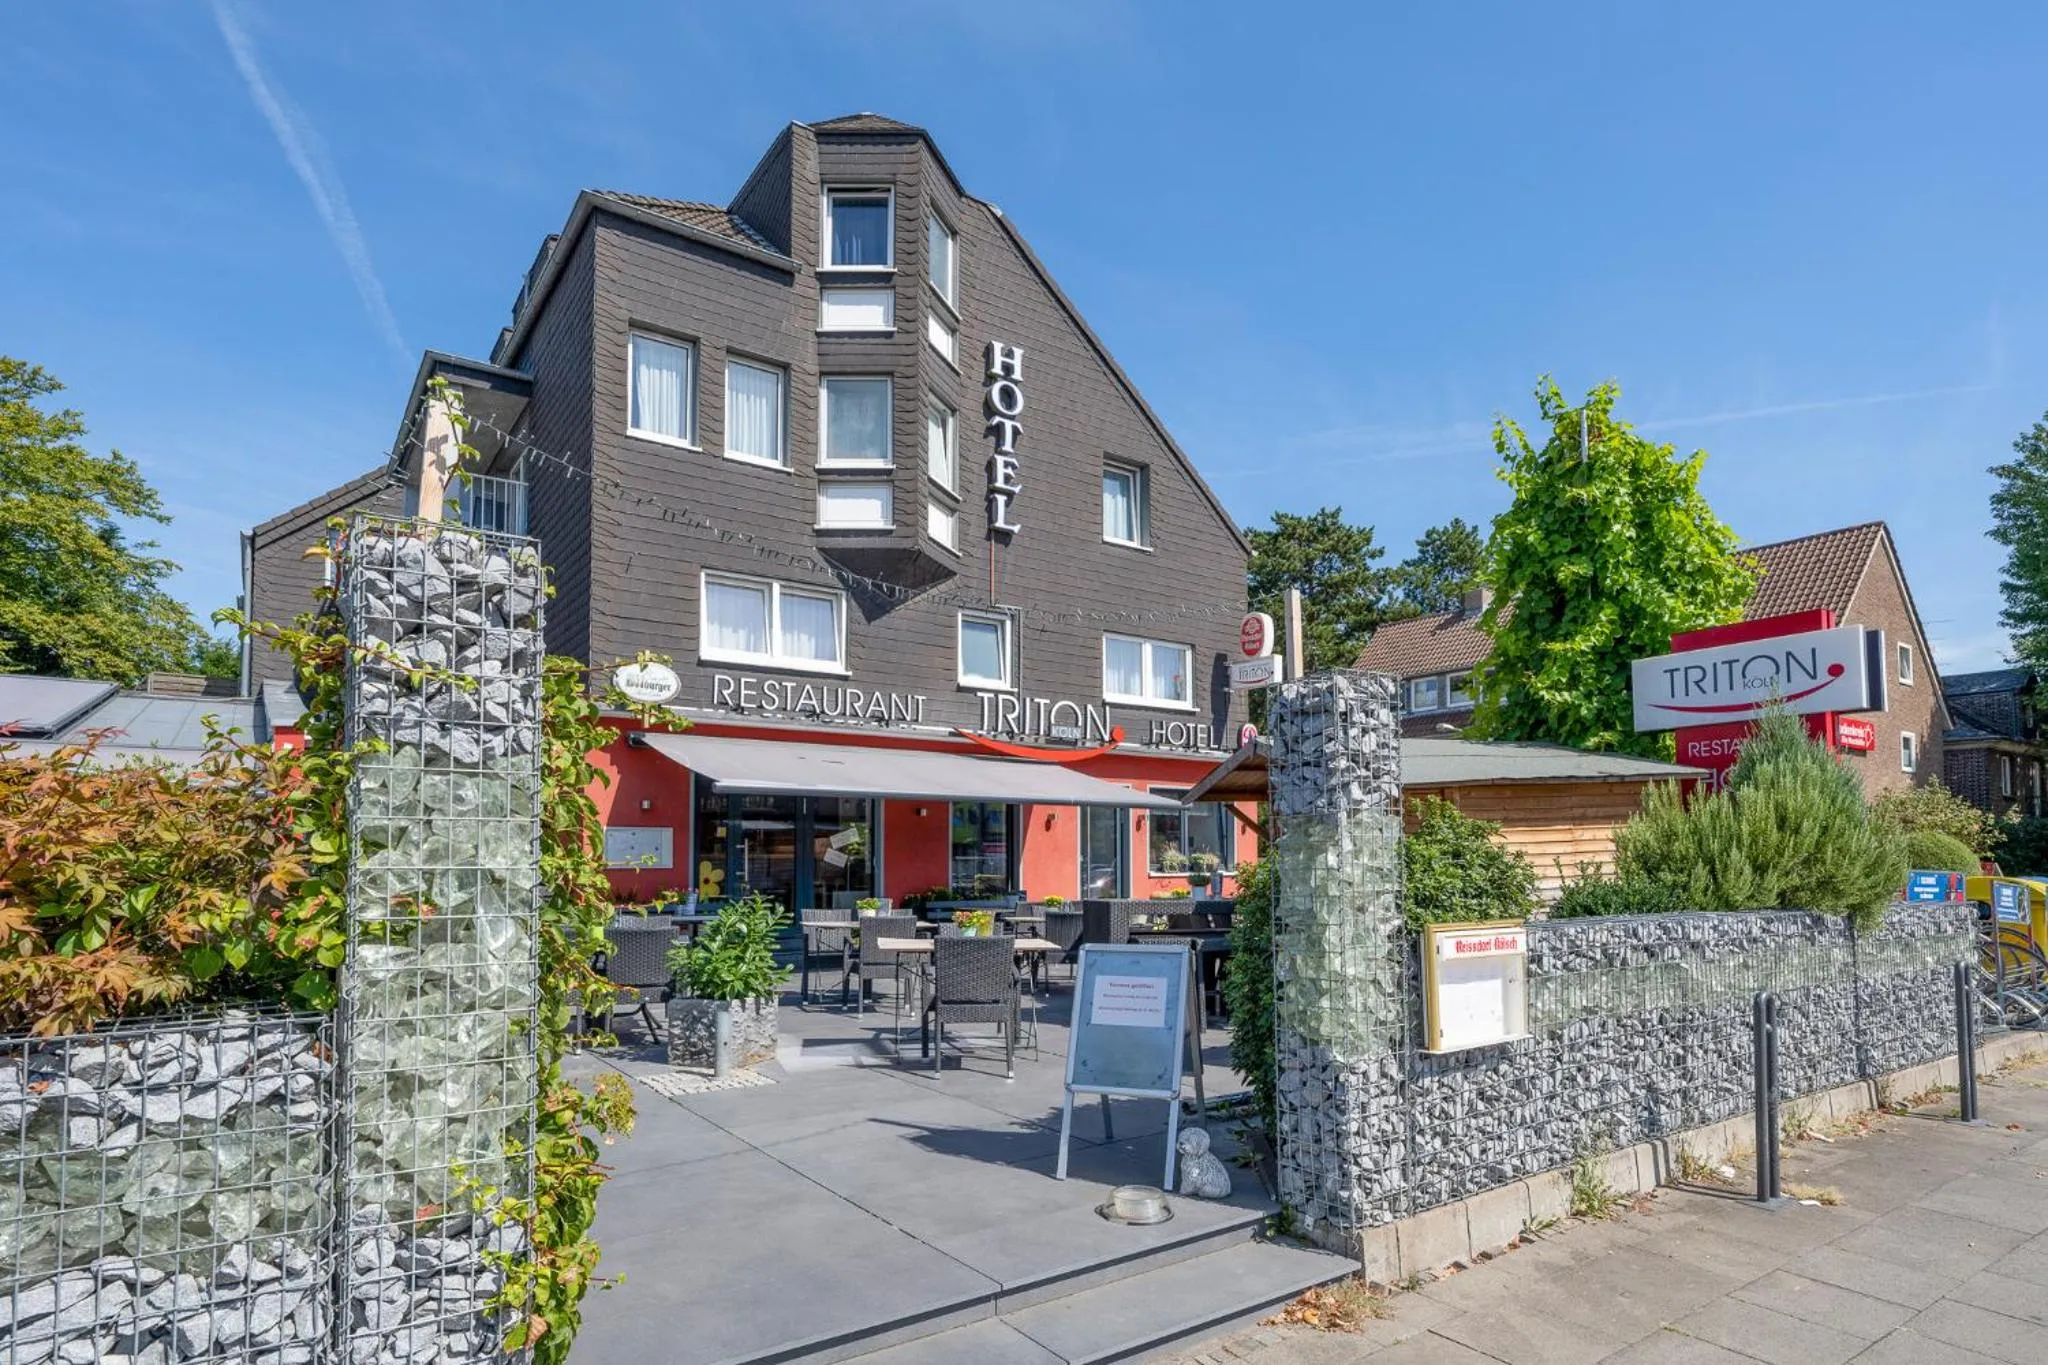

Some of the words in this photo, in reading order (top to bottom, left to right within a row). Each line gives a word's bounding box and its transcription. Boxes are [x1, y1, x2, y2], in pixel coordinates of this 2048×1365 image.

[987, 340, 1025, 535] HOTEL
[1662, 647, 1819, 699] TRITON
[713, 674, 928, 723] RESTAURANT
[976, 691, 1111, 743] TRITON
[1151, 719, 1219, 748] HOTEL
